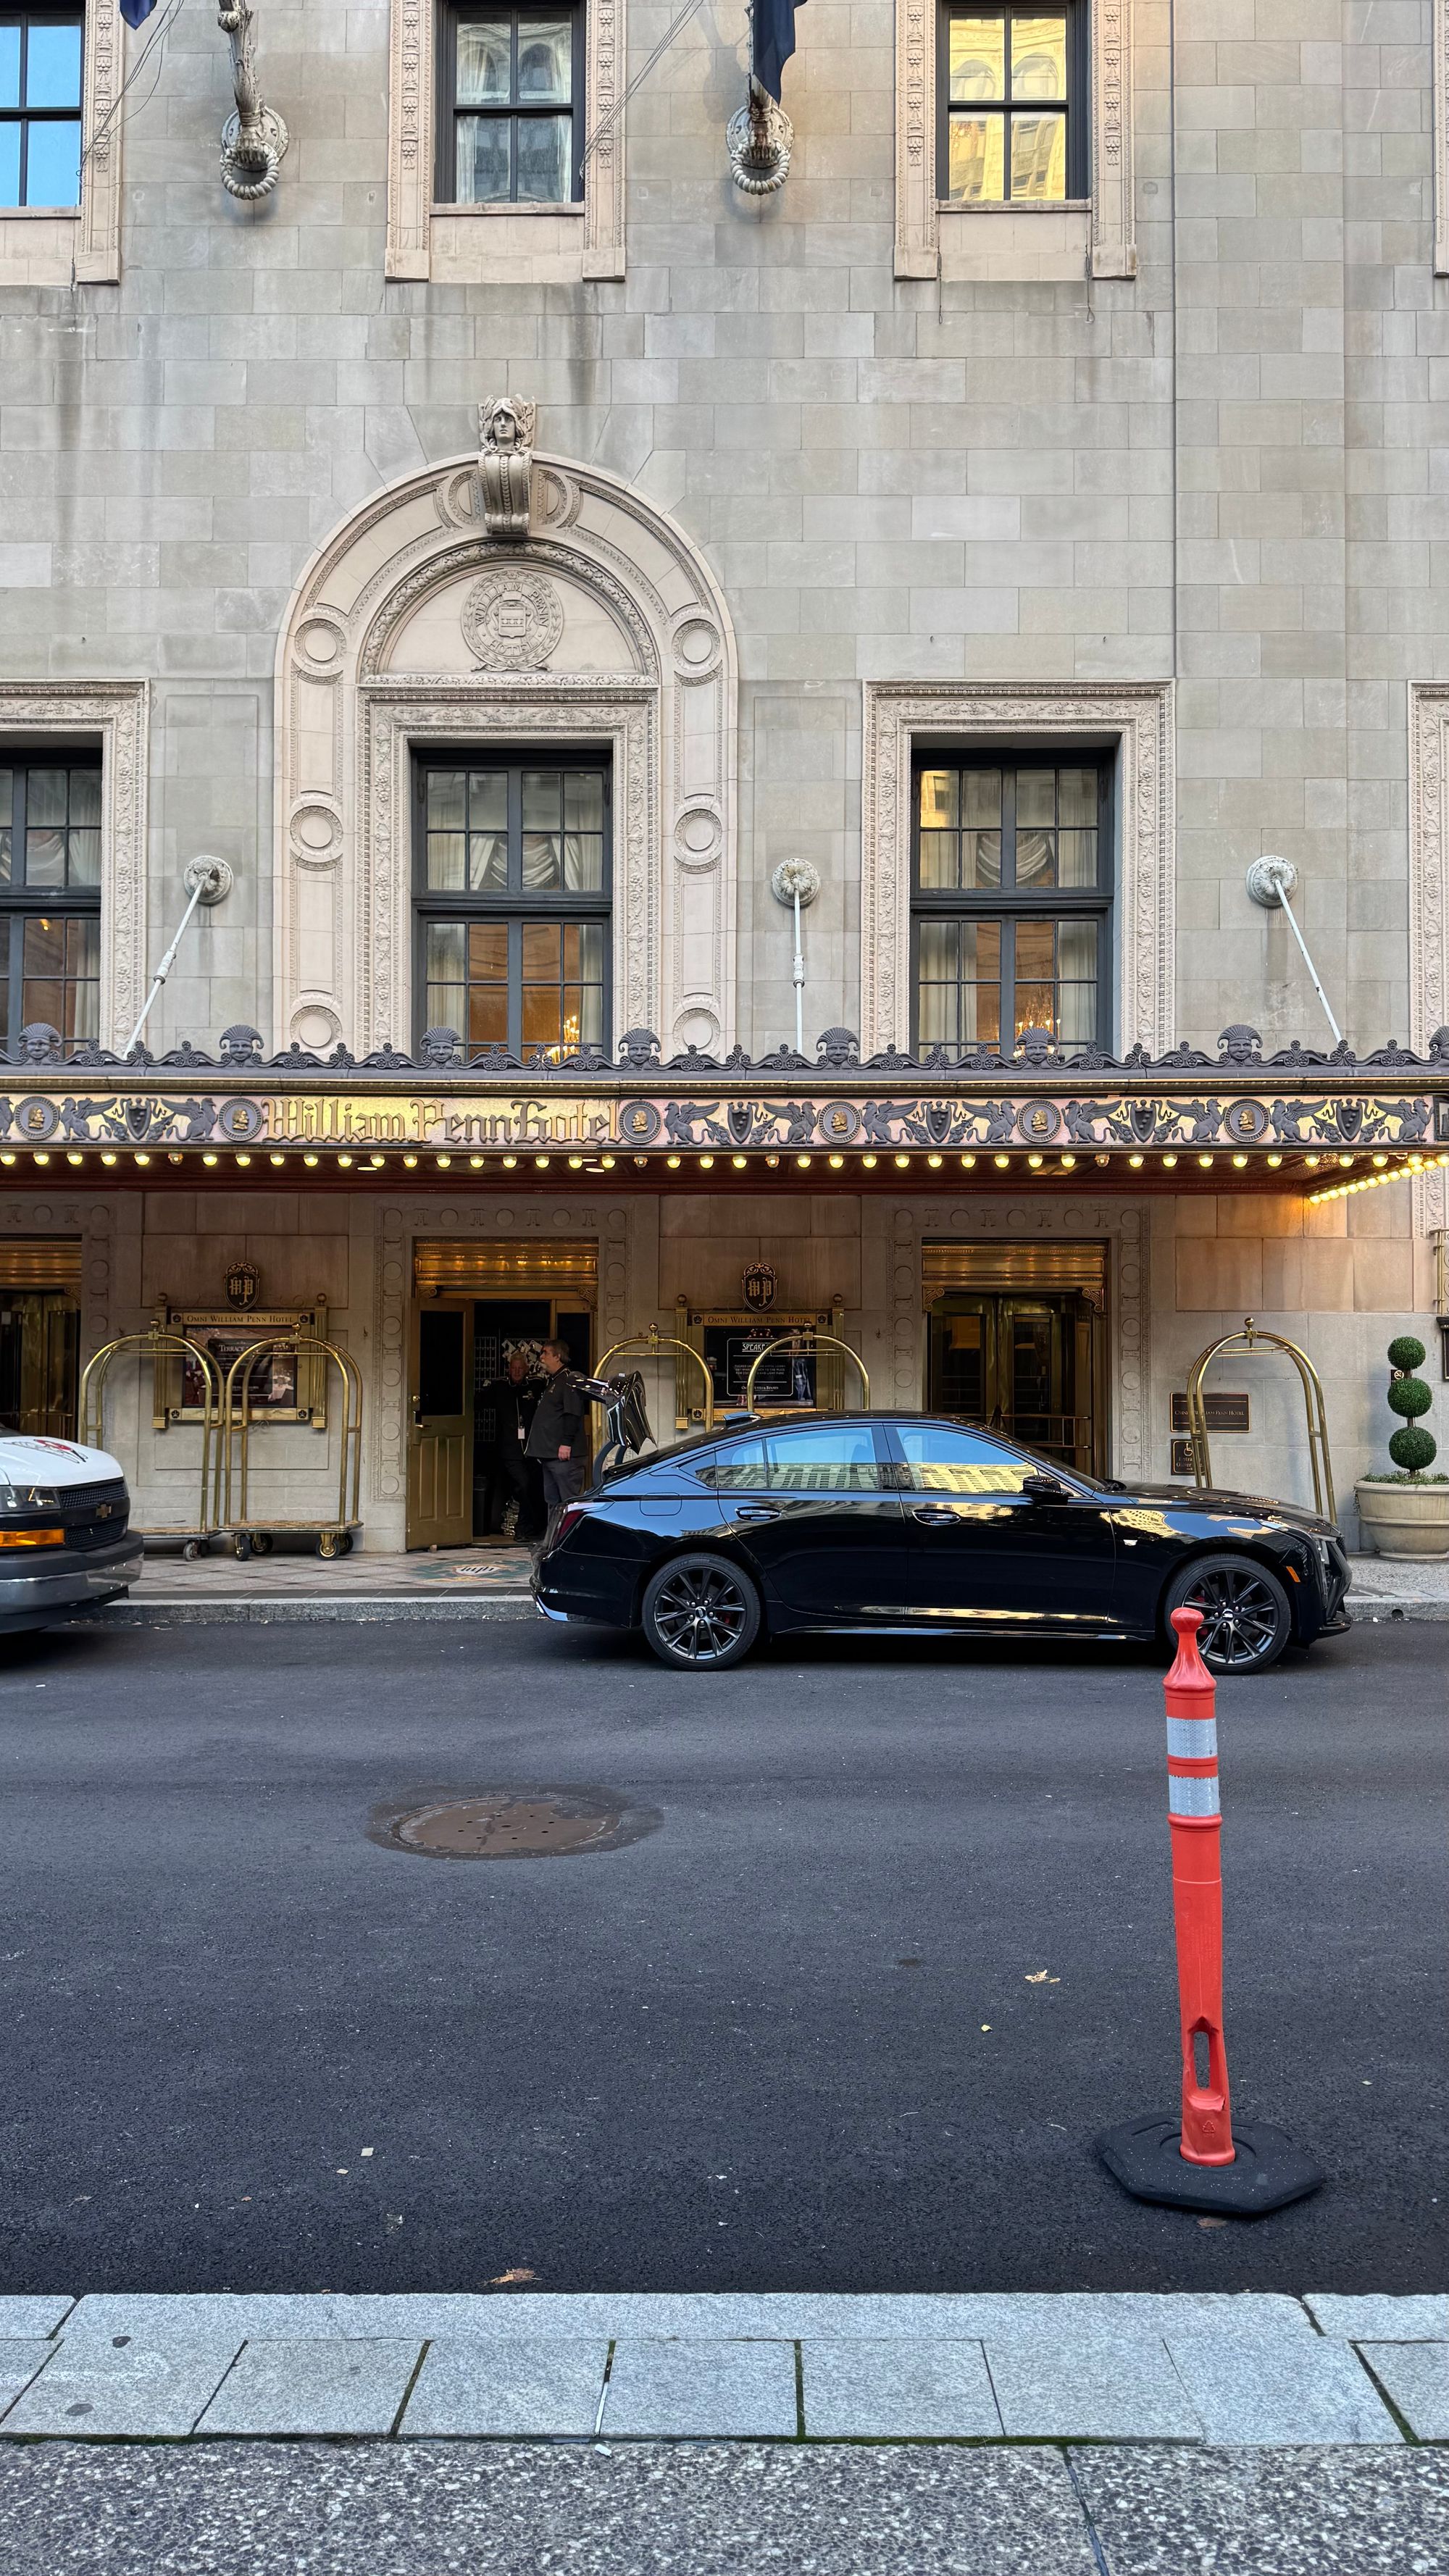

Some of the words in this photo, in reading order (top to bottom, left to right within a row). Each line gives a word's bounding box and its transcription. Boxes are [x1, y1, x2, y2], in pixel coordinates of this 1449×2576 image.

[475, 584, 523, 627] WILLIAM
[529, 590, 548, 628] PENN
[488, 639, 538, 656] HOTEL
[262, 1097, 408, 1143] William
[406, 1098, 513, 1144] Penn
[509, 1099, 621, 1144] Hotel
